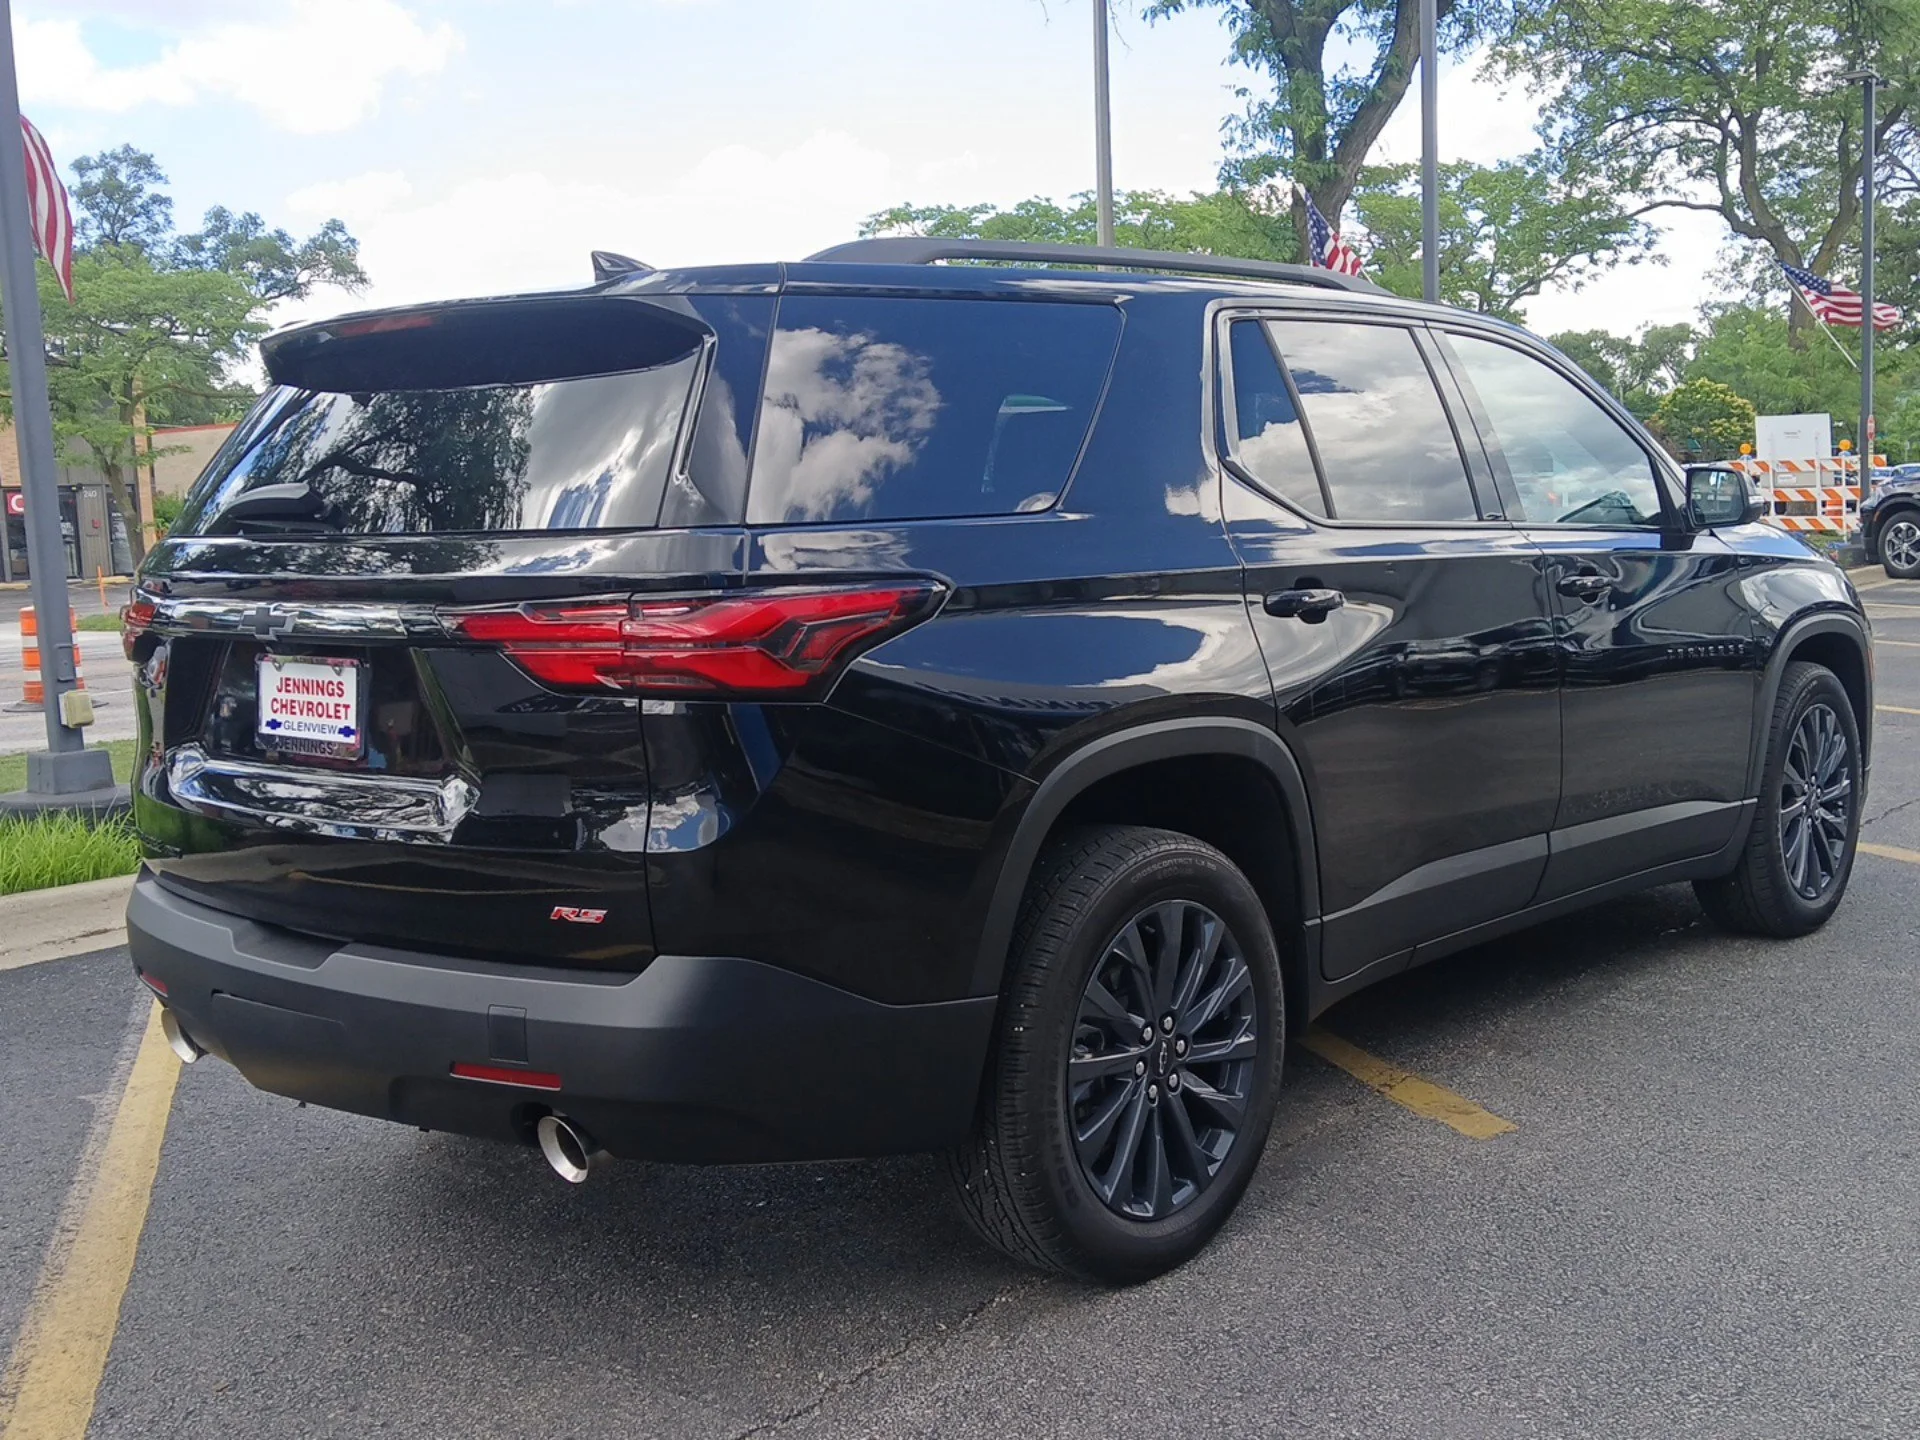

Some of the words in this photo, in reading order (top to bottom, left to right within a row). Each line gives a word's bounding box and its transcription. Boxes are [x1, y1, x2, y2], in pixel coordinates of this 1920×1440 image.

[276, 676, 345, 698] JENNINGS
[270, 697, 351, 720] CHEVROLET
[283, 720, 339, 735] GLENVIEW
[277, 738, 334, 755] JENNINGS
[550, 906, 609, 924] RS
